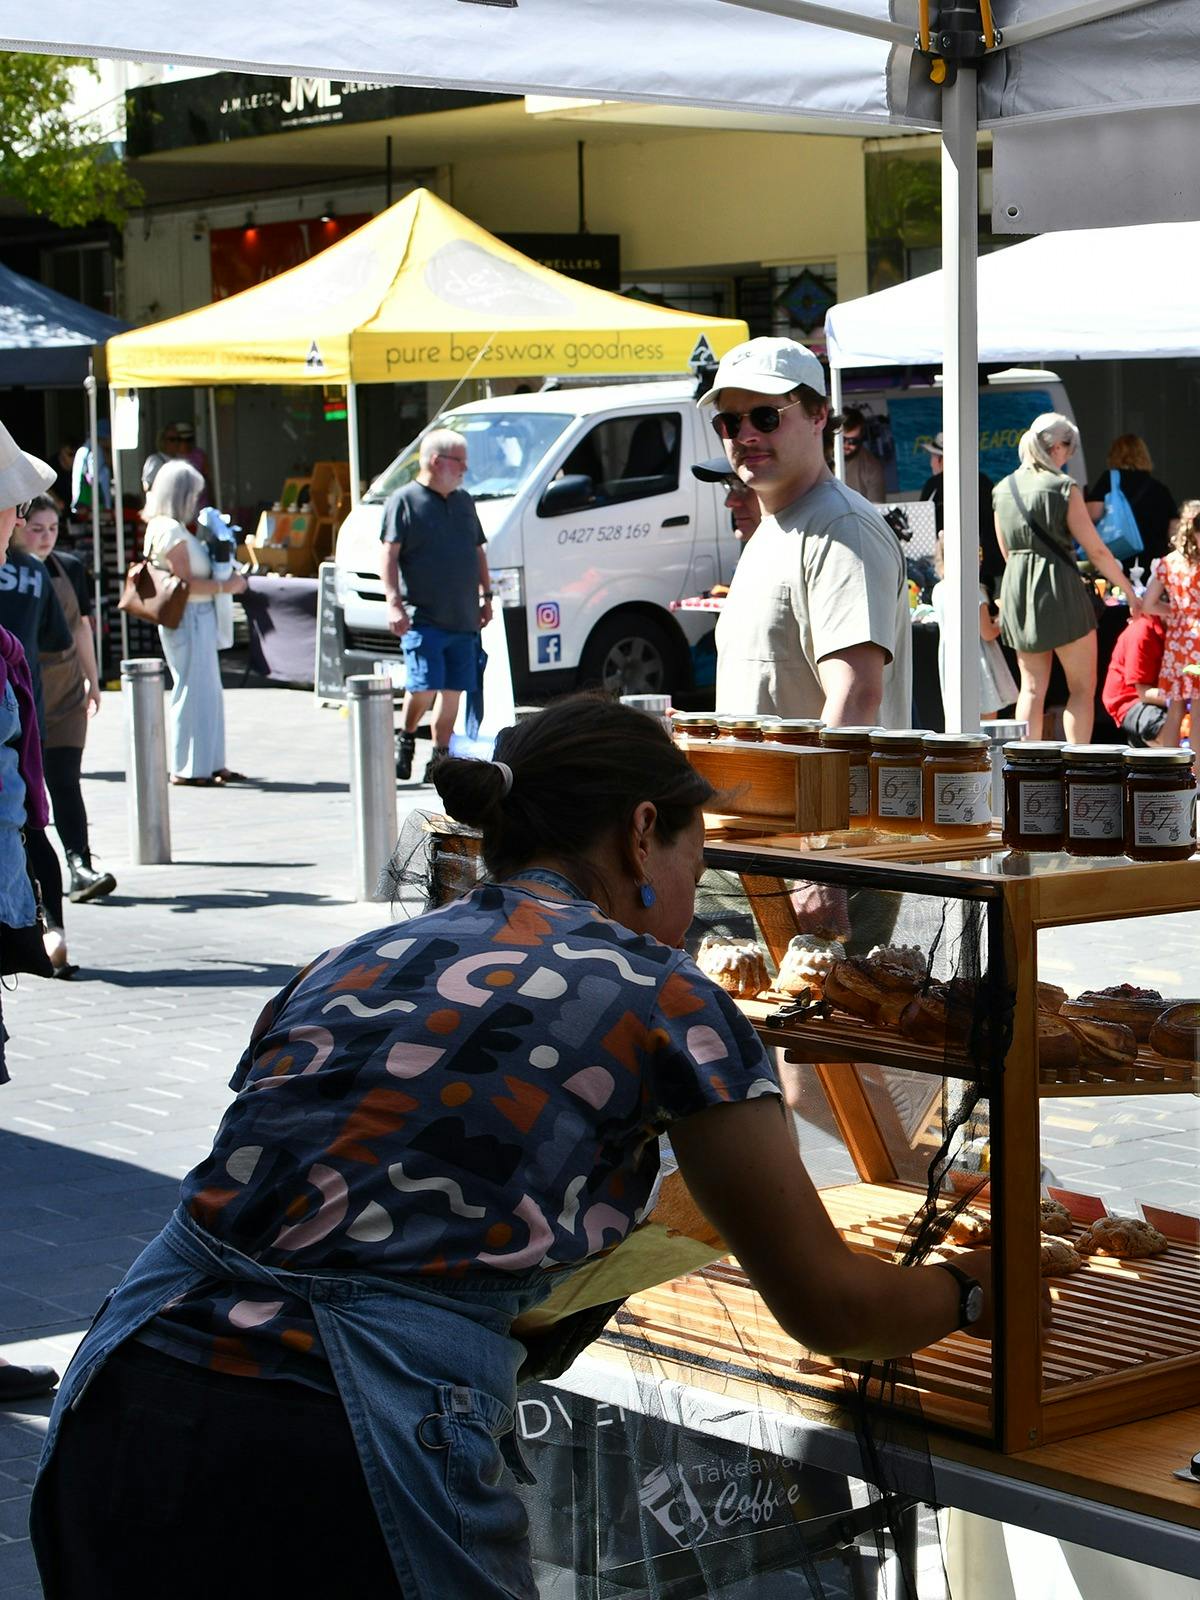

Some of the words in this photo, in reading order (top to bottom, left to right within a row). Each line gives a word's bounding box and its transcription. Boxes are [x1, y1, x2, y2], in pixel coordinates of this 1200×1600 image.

[281, 77, 342, 113] JML
[385, 343, 441, 373] pure
[450, 332, 555, 363] beeswax
[564, 331, 664, 368] goodness
[557, 527, 595, 545] 0427
[597, 525, 623, 542] 528
[625, 523, 651, 540] 169
